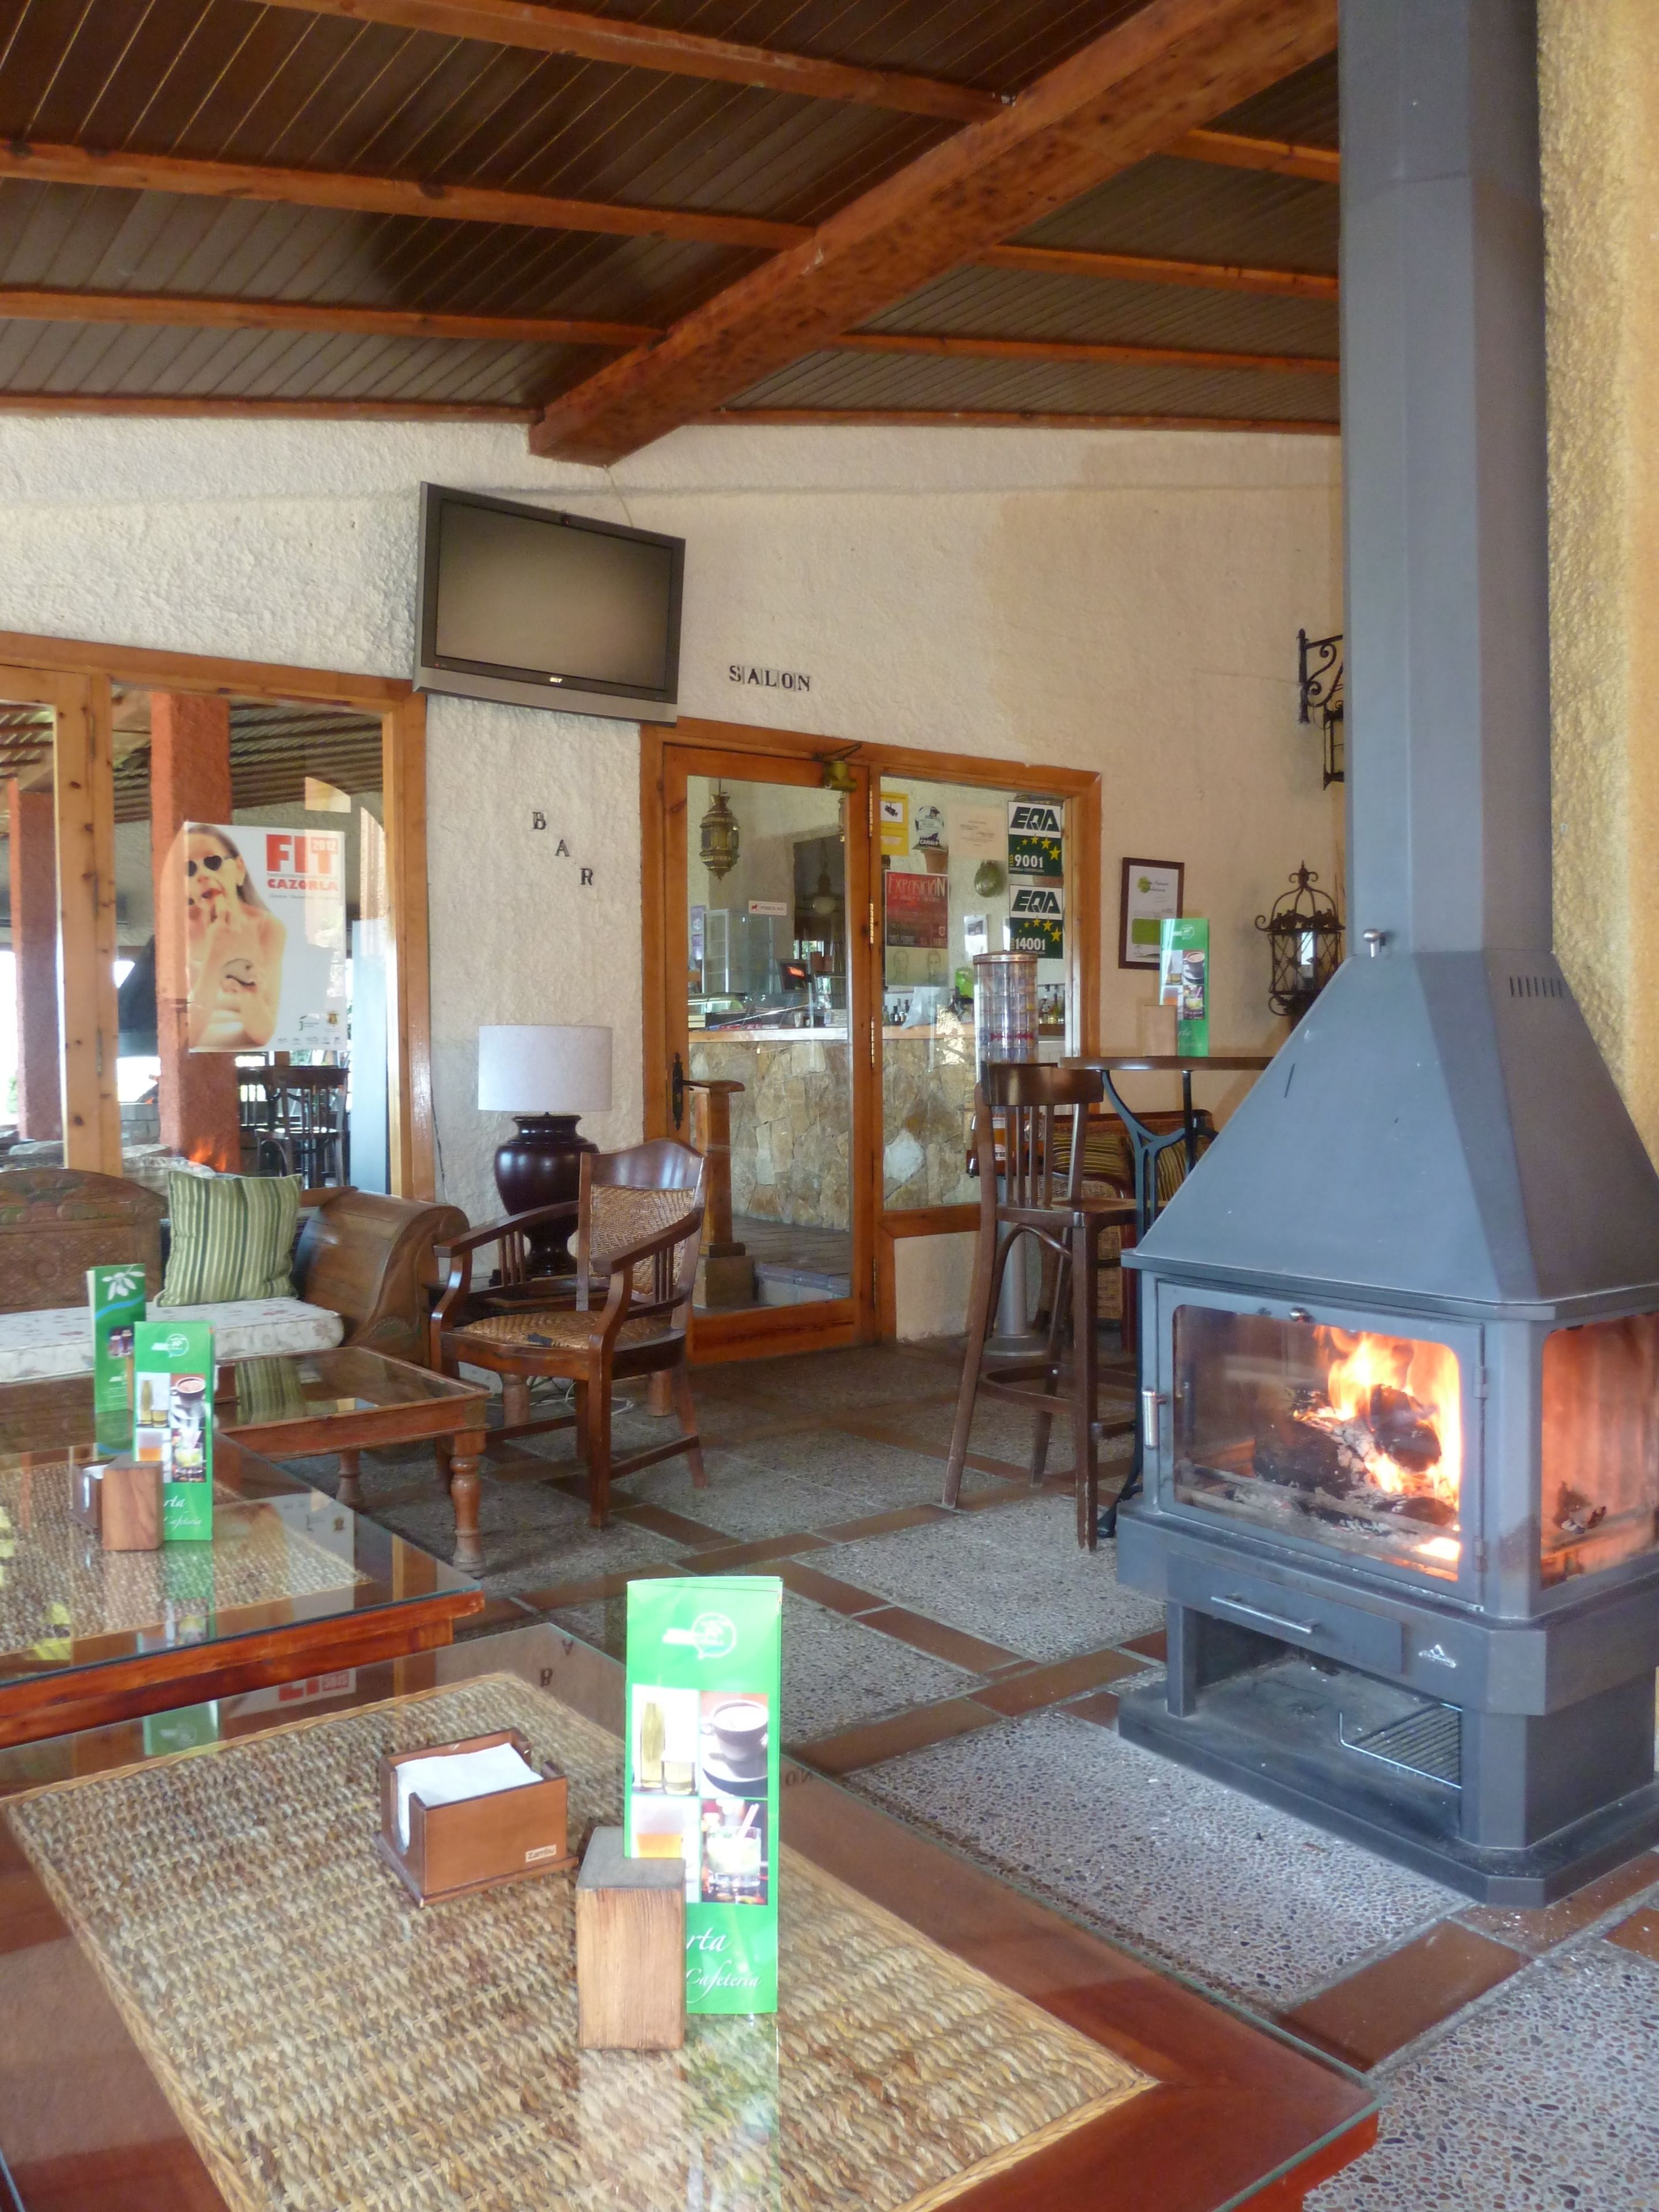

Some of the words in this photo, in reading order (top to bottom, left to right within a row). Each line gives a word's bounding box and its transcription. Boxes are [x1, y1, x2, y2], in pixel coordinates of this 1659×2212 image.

[729, 665, 810, 692] SALON
[312, 840, 336, 851] 2012
[266, 834, 339, 874] FIT
[1014, 854, 1043, 868] 9001
[267, 878, 338, 891] CAZORLA
[1016, 937, 1046, 950] 14001
[163, 1495, 185, 1508] rta
[686, 1927, 733, 1952] rta
